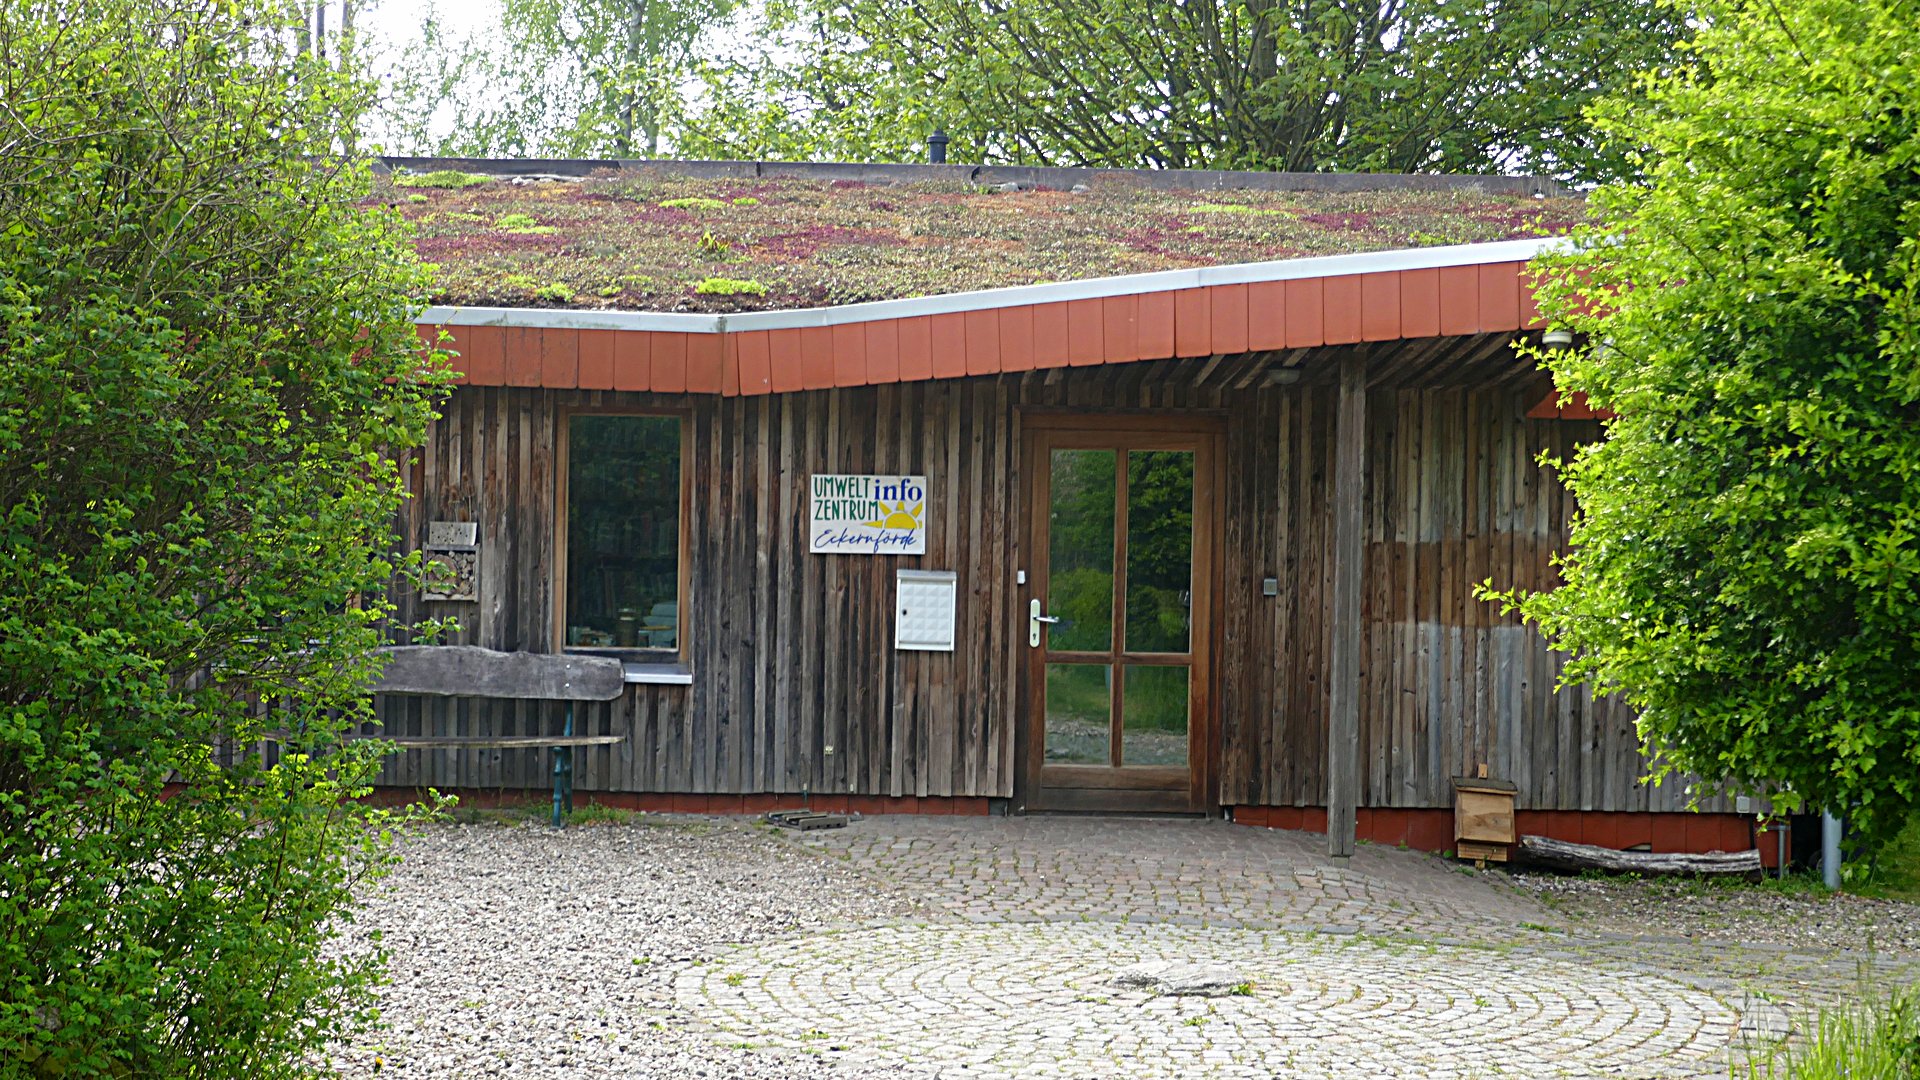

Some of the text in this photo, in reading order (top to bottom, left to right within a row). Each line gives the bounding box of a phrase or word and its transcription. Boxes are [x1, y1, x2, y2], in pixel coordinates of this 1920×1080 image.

[815, 477, 923, 501] UMWELT info
[815, 500, 878, 521] ZENTRUM
[815, 527, 917, 554] Eckernförde
